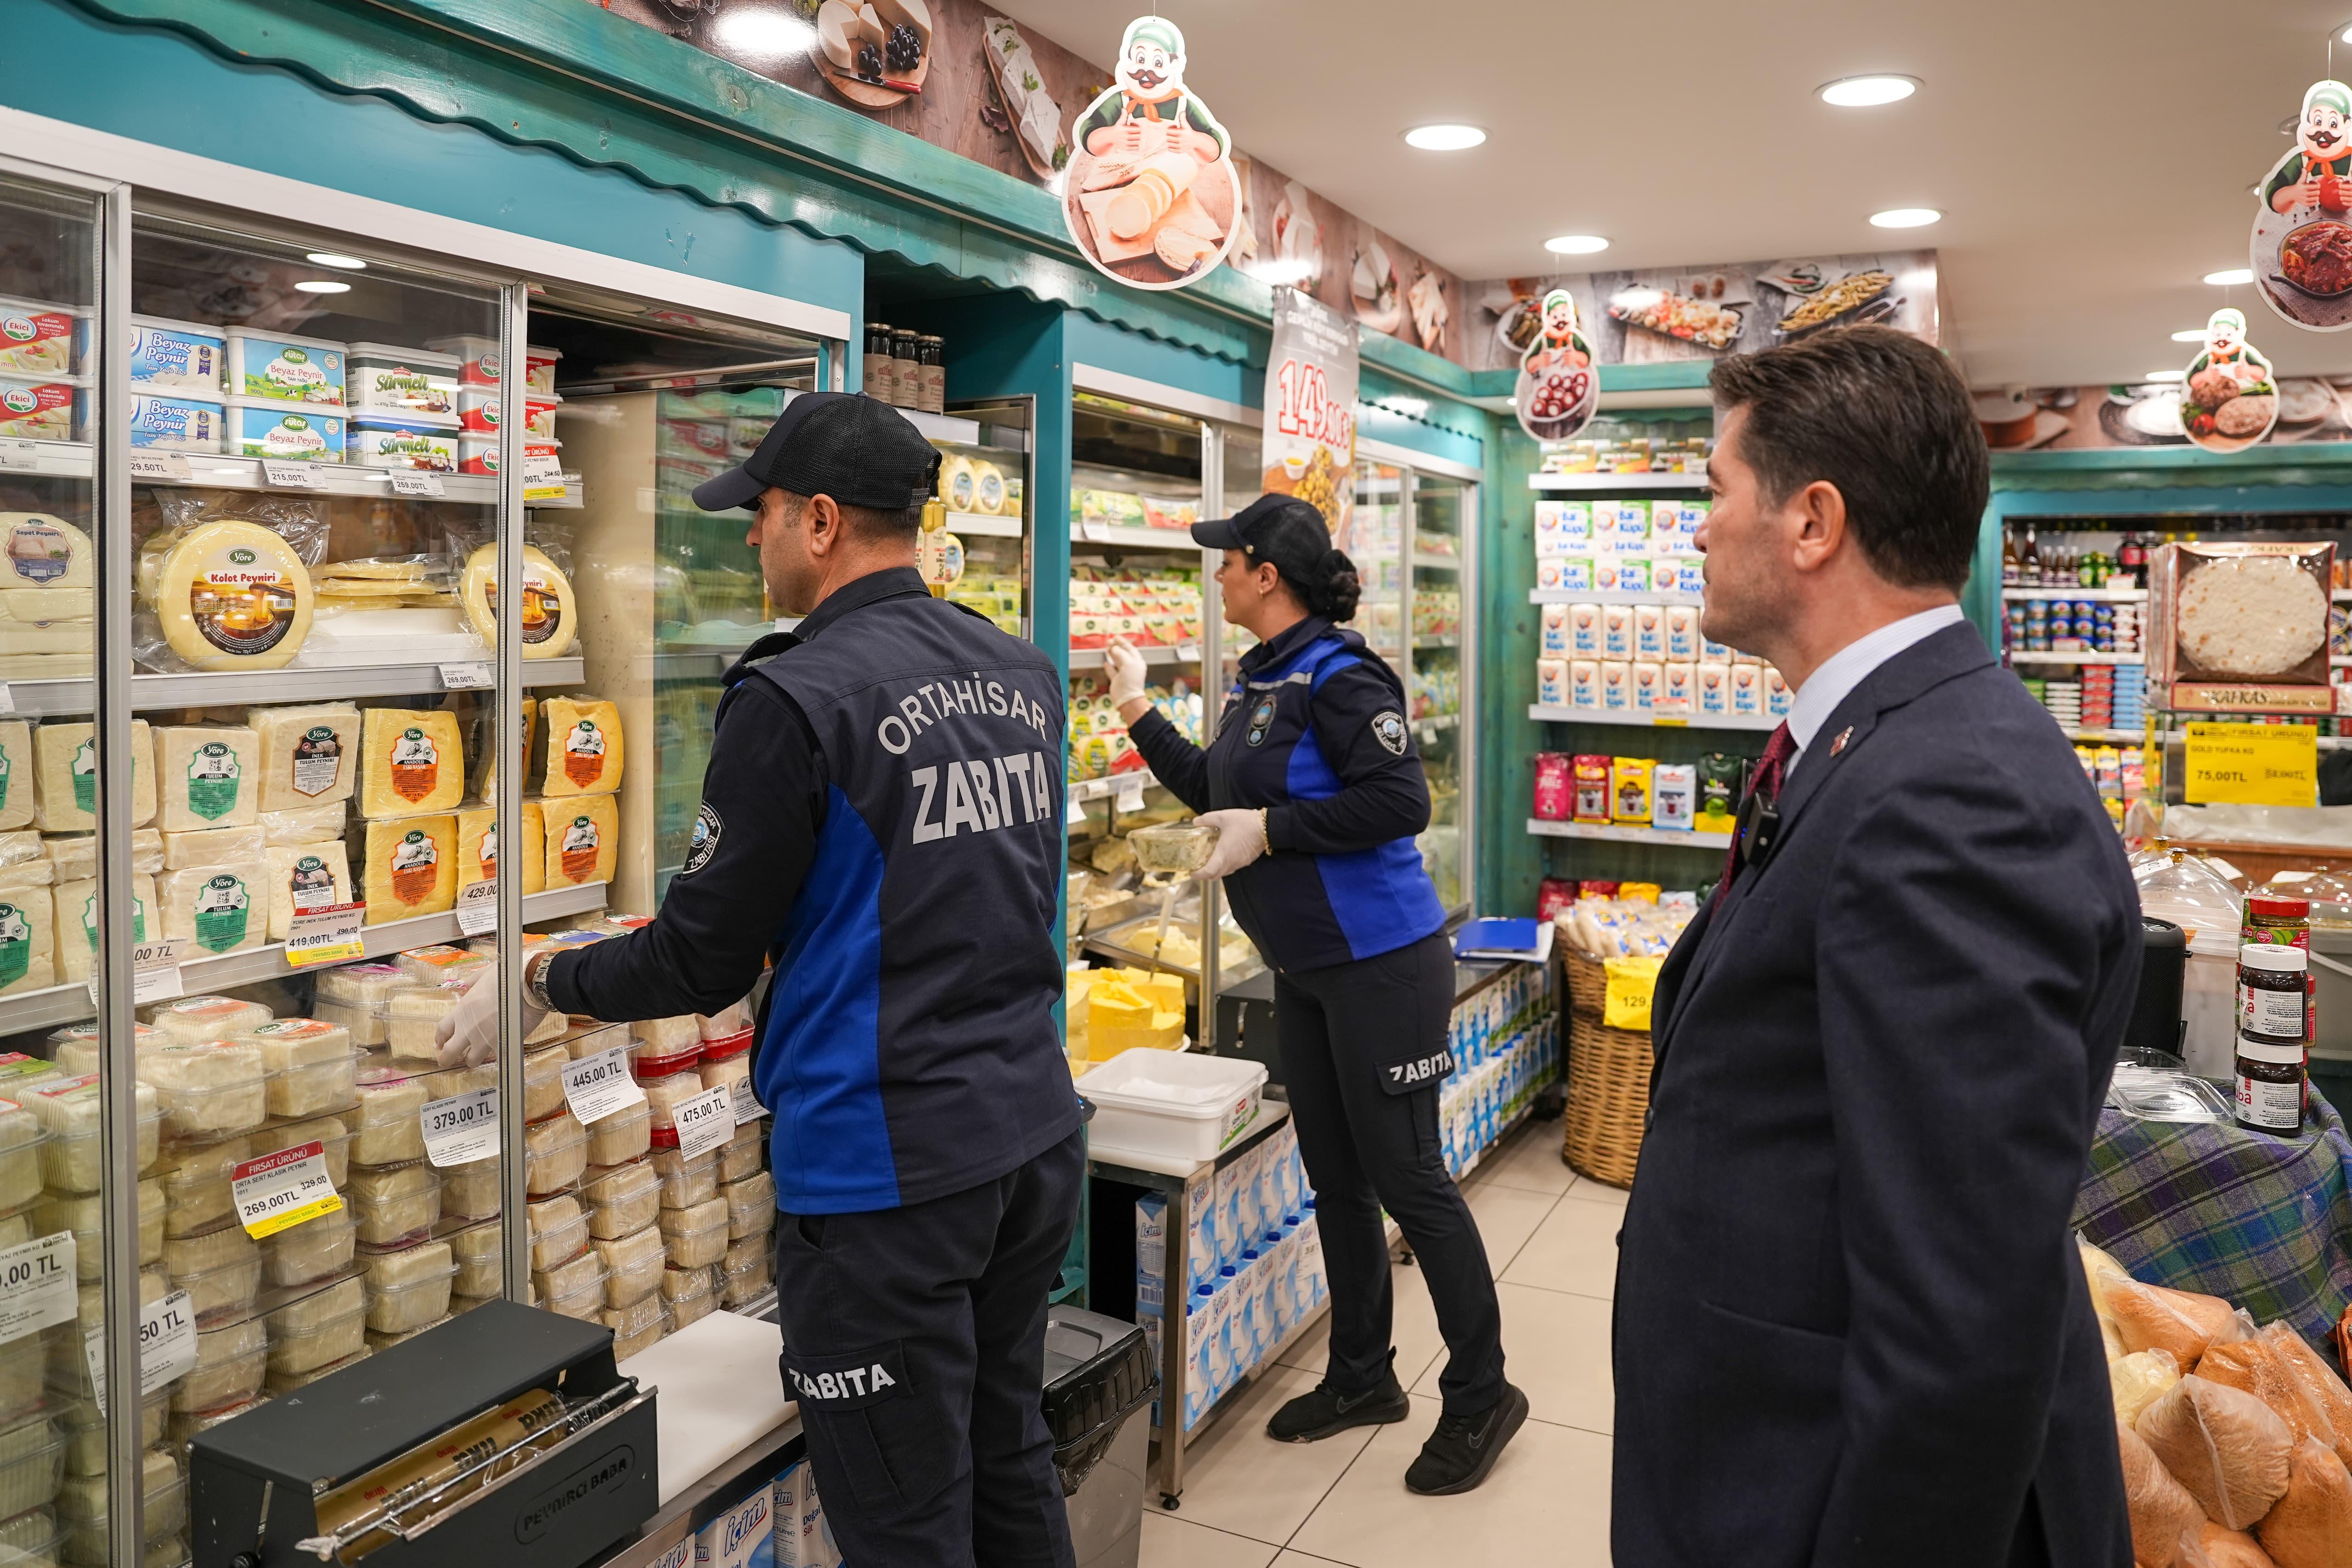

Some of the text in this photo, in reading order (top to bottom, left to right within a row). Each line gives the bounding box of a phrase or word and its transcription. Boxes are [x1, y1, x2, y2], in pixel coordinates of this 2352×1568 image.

[10, 323, 29, 331] Ekici
[37, 321, 65, 330] kıvamında
[152, 333, 191, 353] Beyaz
[146, 346, 188, 365] Peynir
[159, 366, 174, 374] Yağlı
[485, 359, 500, 368] Ekici
[271, 365, 322, 379] Beyaz Peynir
[375, 374, 429, 392] Sürmeli
[11, 395, 30, 403] Ekici
[151, 400, 190, 419] Beyaz
[143, 413, 186, 431] Peynir
[270, 433, 322, 446] Beyaz Peynir
[379, 436, 431, 456] Sürmeli
[271, 473, 308, 482] 215,00TL
[396, 481, 428, 490] 259,00TL
[234, 552, 252, 562] Yöre
[211, 572, 276, 583] Kolot Peyniri
[2212, 690, 2267, 704] KAFKAS
[877, 671, 1047, 755] ORTAHİSAR
[581, 721, 593, 730] Yöre
[311, 730, 328, 739] Yöre
[407, 730, 420, 739] Yöre
[206, 745, 224, 755] Yöre
[911, 751, 1052, 844] ZABITA
[577, 818, 588, 827] Yöre
[408, 834, 421, 843] Yöre
[688, 835, 716, 869] ZABITASI
[302, 860, 318, 869] Yöre
[214, 878, 232, 888] Yöre
[289, 934, 334, 947] 419,00TL
[157, 945, 173, 958] TL
[1390, 1049, 1453, 1084] ZABITA
[573, 1061, 622, 1088] 445.00 TL
[434, 1101, 494, 1130] 379.00 TL
[683, 1102, 712, 1123] 475.00
[712, 1098, 725, 1111] TL
[249, 1147, 307, 1174] FIRSAT ÜRÜNÜ
[236, 1178, 251, 1189] ORTA
[252, 1174, 267, 1184] SERT
[300, 1175, 327, 1190] 329,00
[244, 1191, 300, 1217] 269,00TL
[1140, 1223, 1161, 1238] İçim
[36, 1254, 62, 1274] TL
[162, 1309, 185, 1330] TL
[788, 1363, 896, 1399] ZABITA
[502, 1408, 523, 1421] Wrap
[436, 1443, 459, 1459] Wrap
[590, 1457, 628, 1489] BABA
[363, 1485, 389, 1501] Wrap
[803, 1505, 821, 1526] Doğal
[724, 1497, 765, 1557] İçim
[803, 1525, 814, 1537] Süt
